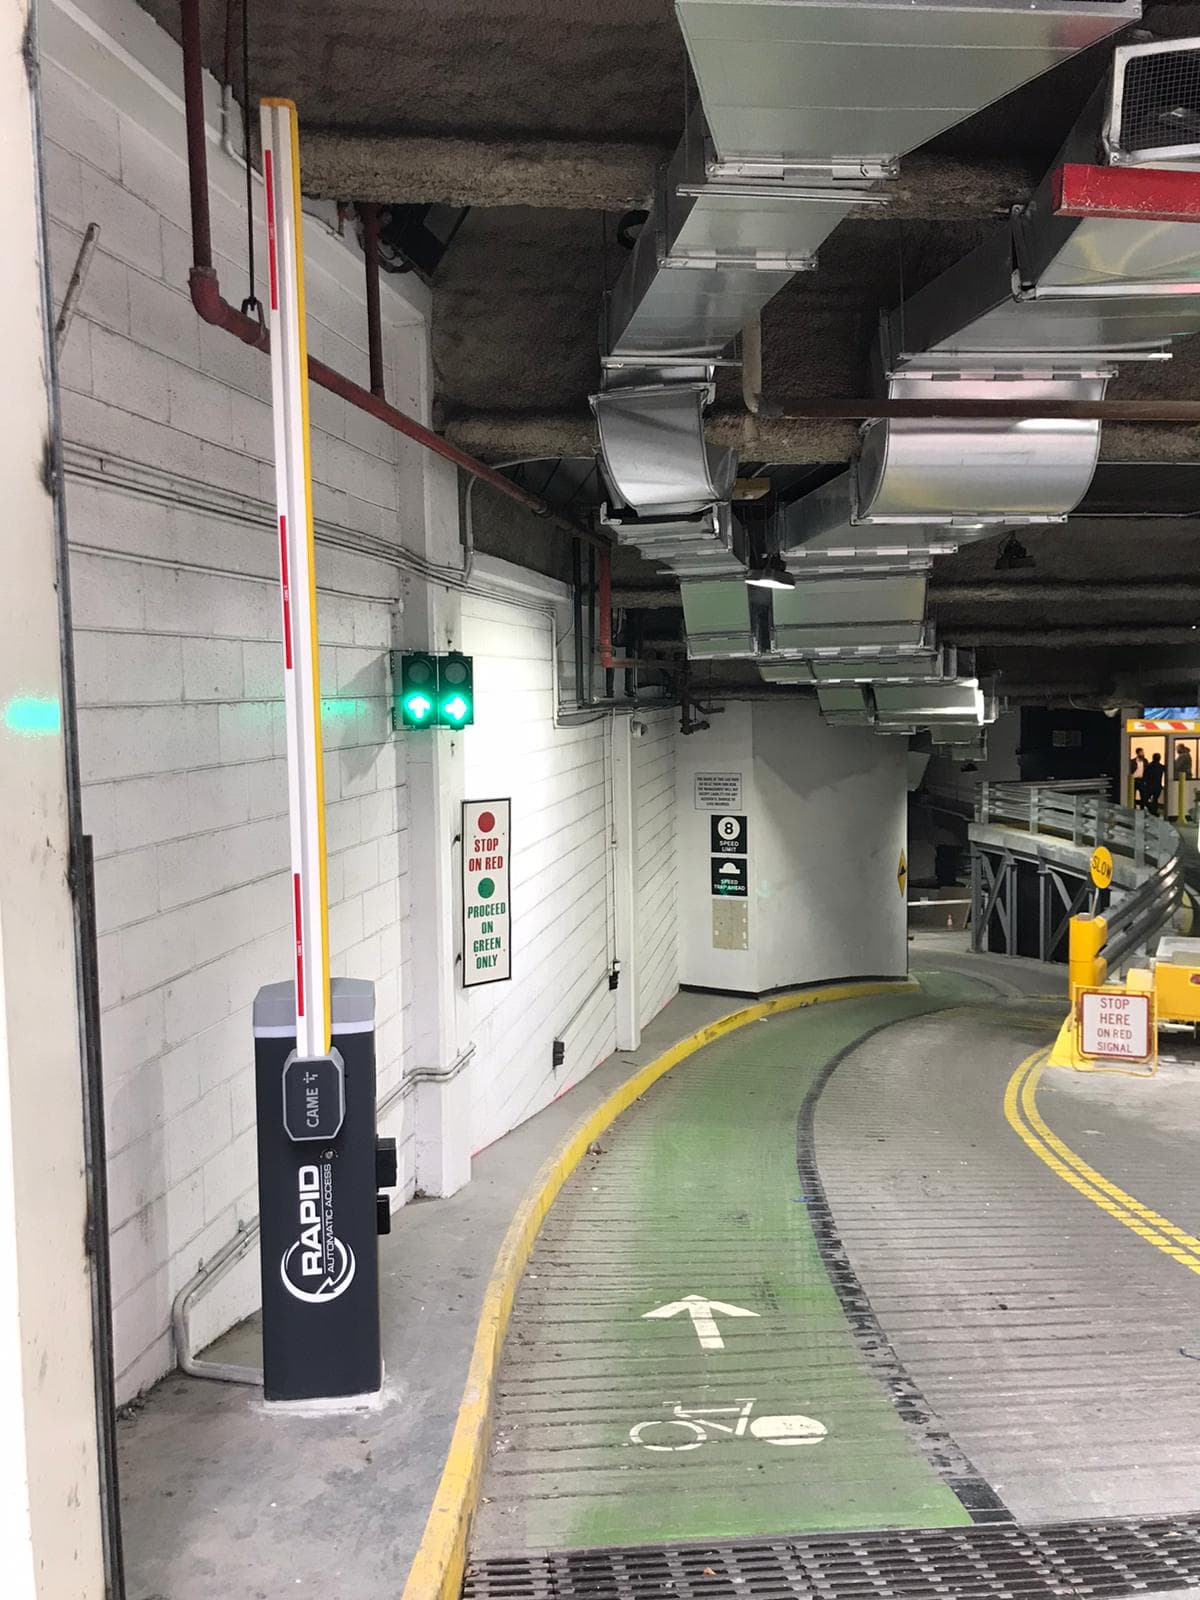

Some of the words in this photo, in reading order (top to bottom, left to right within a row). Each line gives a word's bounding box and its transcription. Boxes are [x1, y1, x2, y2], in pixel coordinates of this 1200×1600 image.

[724, 822, 734, 835] 8
[474, 838, 499, 853] STOP
[468, 858, 482, 872] ON
[485, 856, 504, 871] RED
[1091, 855, 1111, 879] SLOW
[467, 902, 505, 919] PROCEED
[481, 921, 493, 934] ON
[473, 936, 501, 952] GREEN
[476, 955, 498, 969] ONLY
[1100, 997, 1130, 1010] STOP
[1099, 1013, 1131, 1026] HERE
[1097, 1028, 1110, 1038] ON
[1112, 1029, 1132, 1040] RED
[1097, 1041, 1133, 1053] SIGNAL
[306, 1087, 320, 1128] CAME
[323, 1163, 333, 1207] ACCESS
[299, 1165, 323, 1276] RAPID
[324, 1209, 336, 1273] AUTOMATIC
